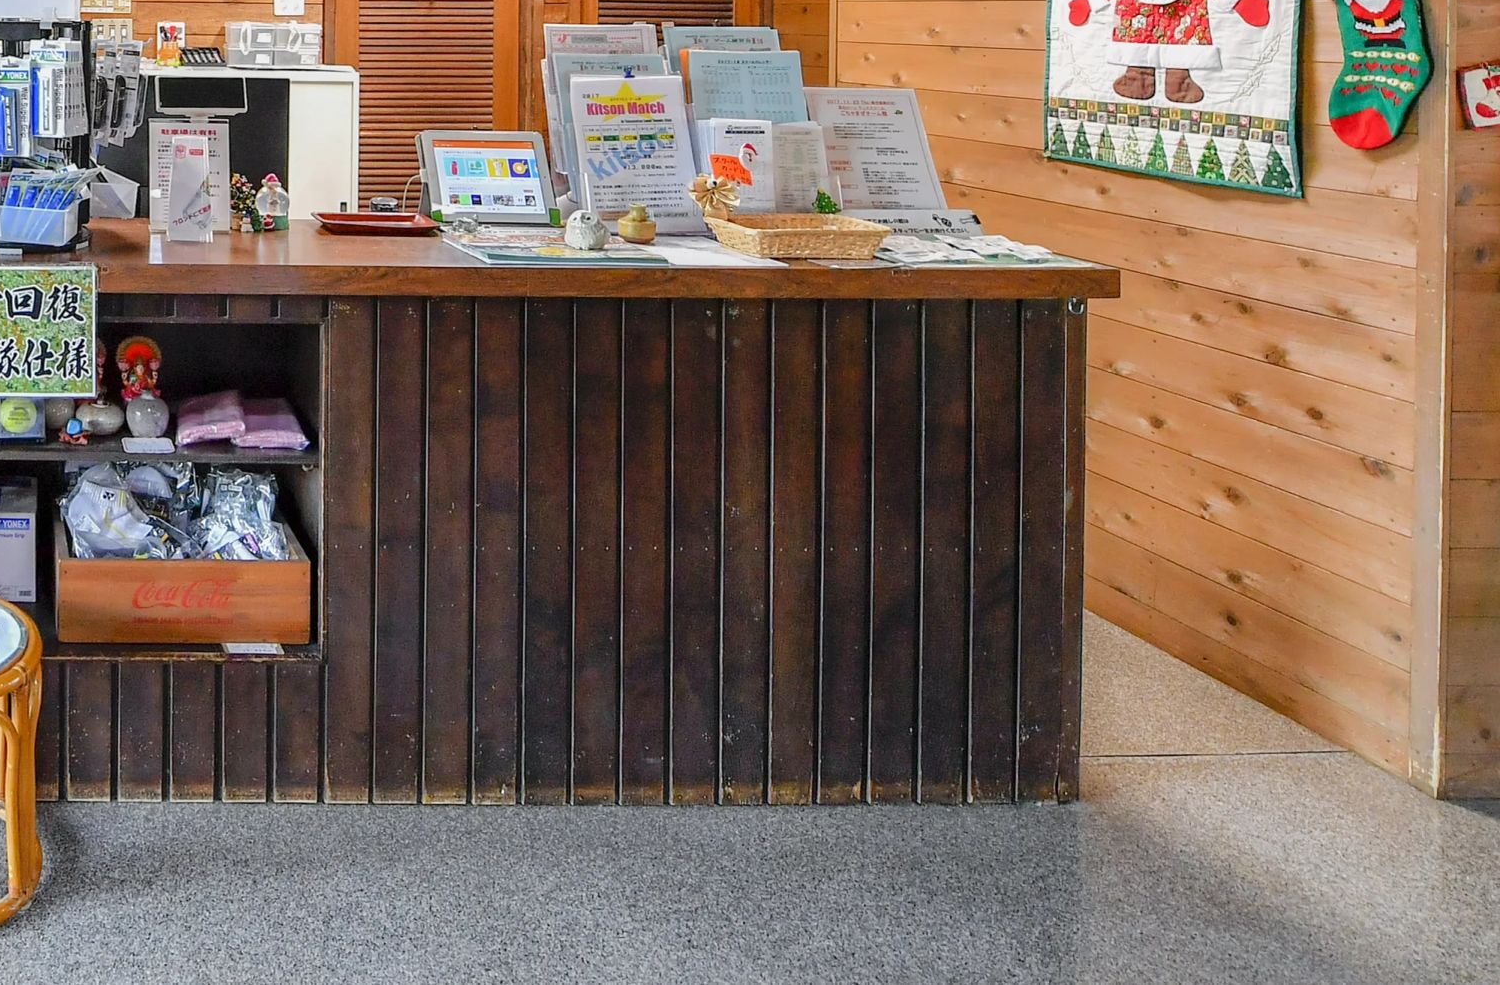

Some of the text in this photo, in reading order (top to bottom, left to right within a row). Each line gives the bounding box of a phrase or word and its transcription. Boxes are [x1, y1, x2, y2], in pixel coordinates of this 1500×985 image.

[6, 71, 28, 80] YONEX
[586, 102, 665, 116] Kitson Match
[2, 519, 30, 528] YONEX
